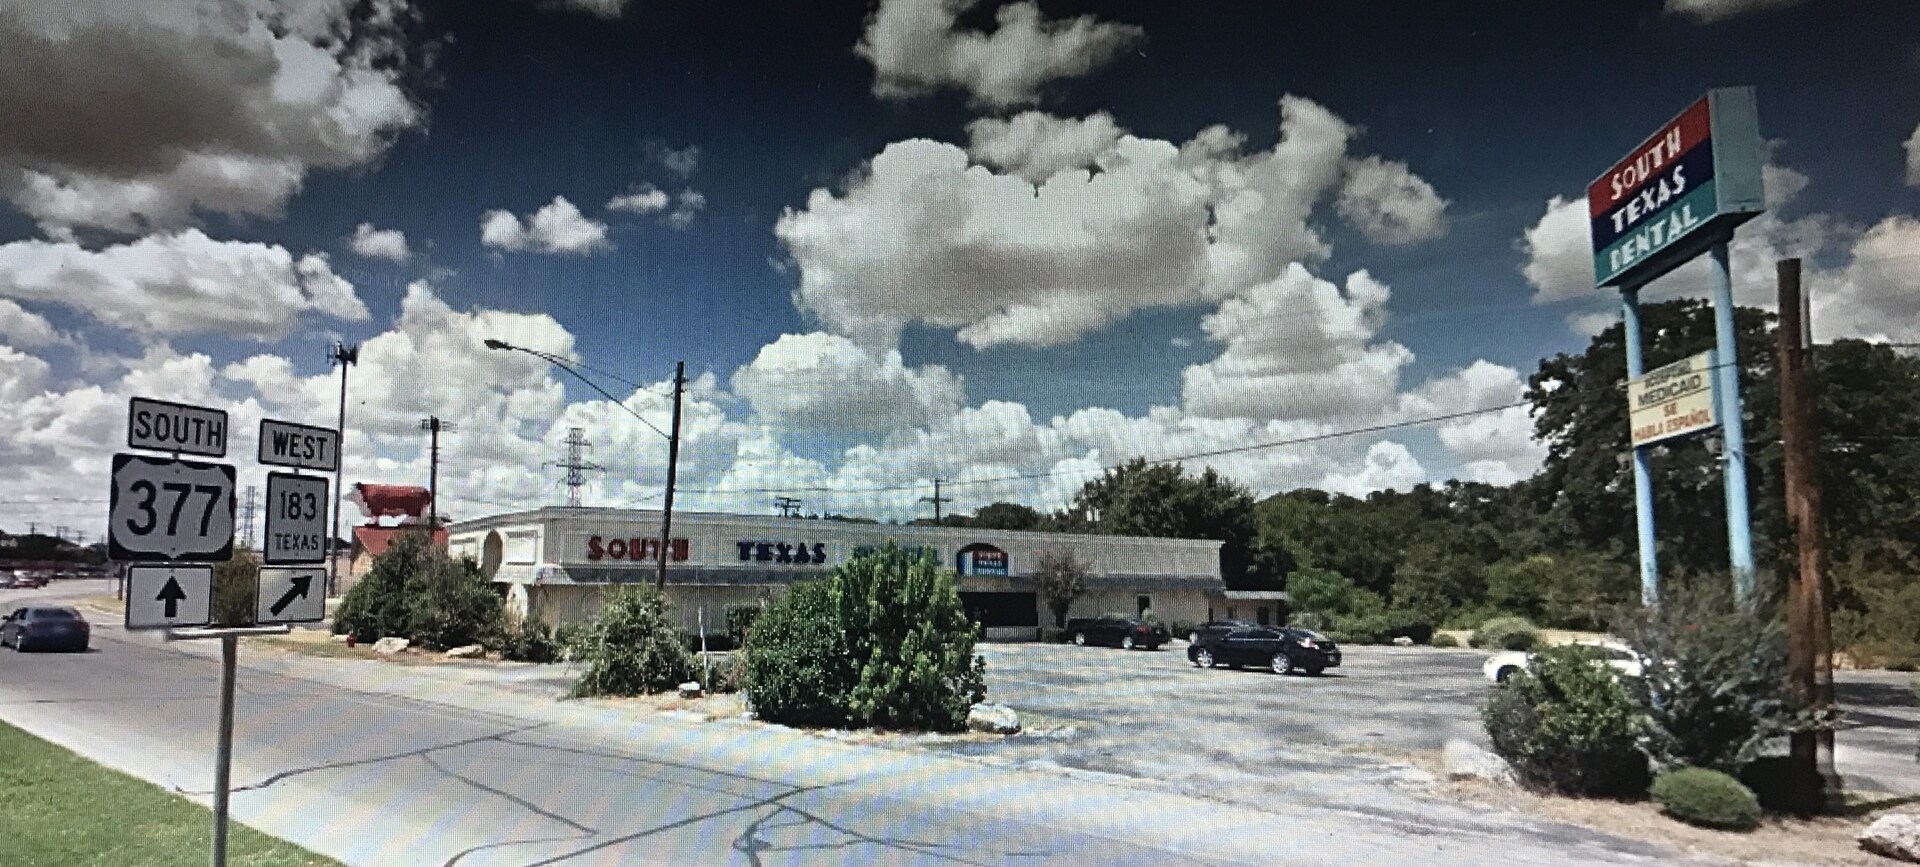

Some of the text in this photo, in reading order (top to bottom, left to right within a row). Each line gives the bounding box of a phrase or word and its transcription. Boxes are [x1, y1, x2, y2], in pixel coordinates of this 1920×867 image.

[1611, 126, 1681, 200] SOUTH
[1610, 164, 1687, 234] TEXAS
[1609, 203, 1699, 272] DENTAL
[1638, 375, 1701, 407] MEDICAID
[134, 410, 222, 448] SOUTH
[272, 430, 328, 461] WEST
[126, 479, 223, 537] 377
[280, 491, 317, 521] 183
[274, 533, 319, 551] TEXAS
[588, 535, 689, 562] SOUTH
[736, 540, 827, 564] TEXAS
